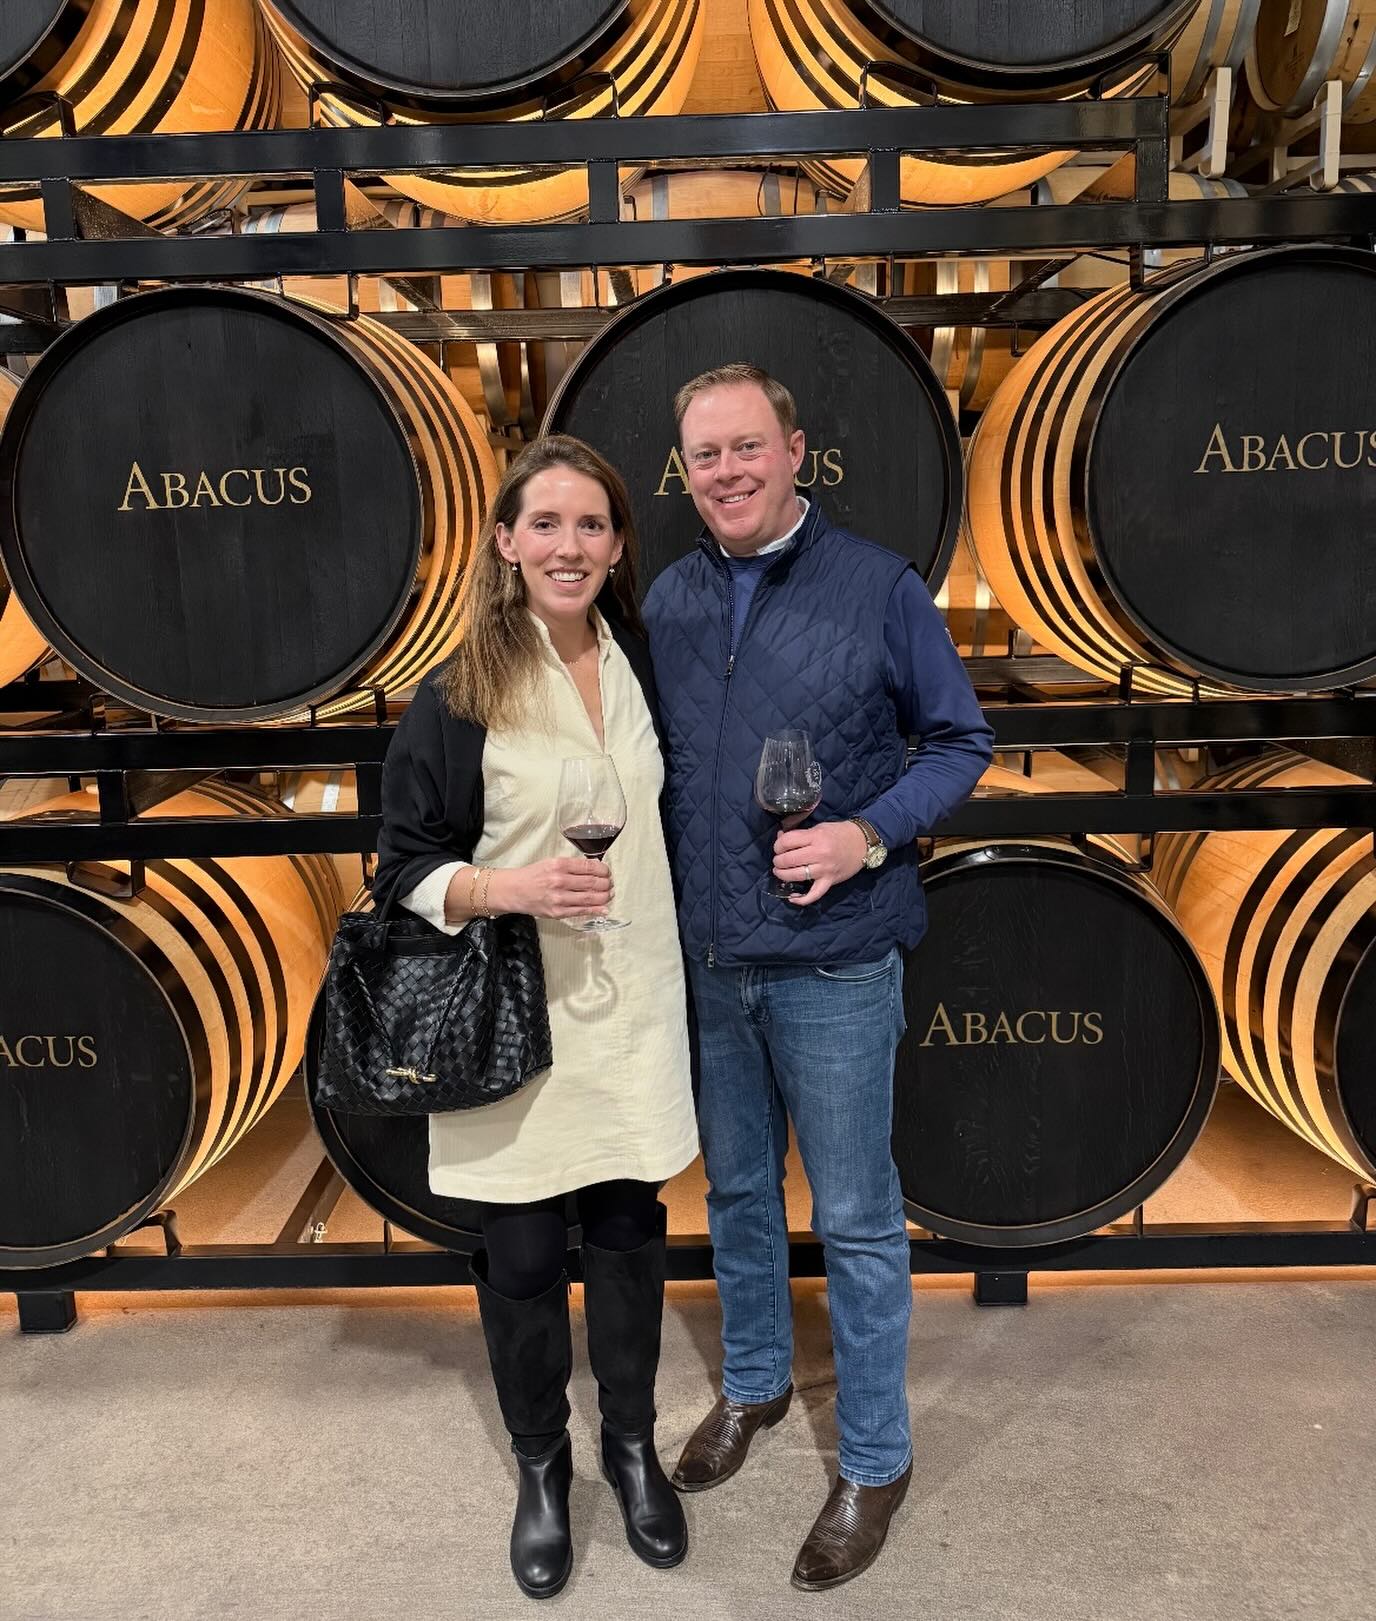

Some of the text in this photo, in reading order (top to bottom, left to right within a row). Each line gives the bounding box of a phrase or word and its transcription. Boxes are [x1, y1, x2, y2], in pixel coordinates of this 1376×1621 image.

[118, 461, 312, 511] ABACUS
[654, 446, 844, 496] AUS
[919, 1002, 1104, 1047] ABACUS
